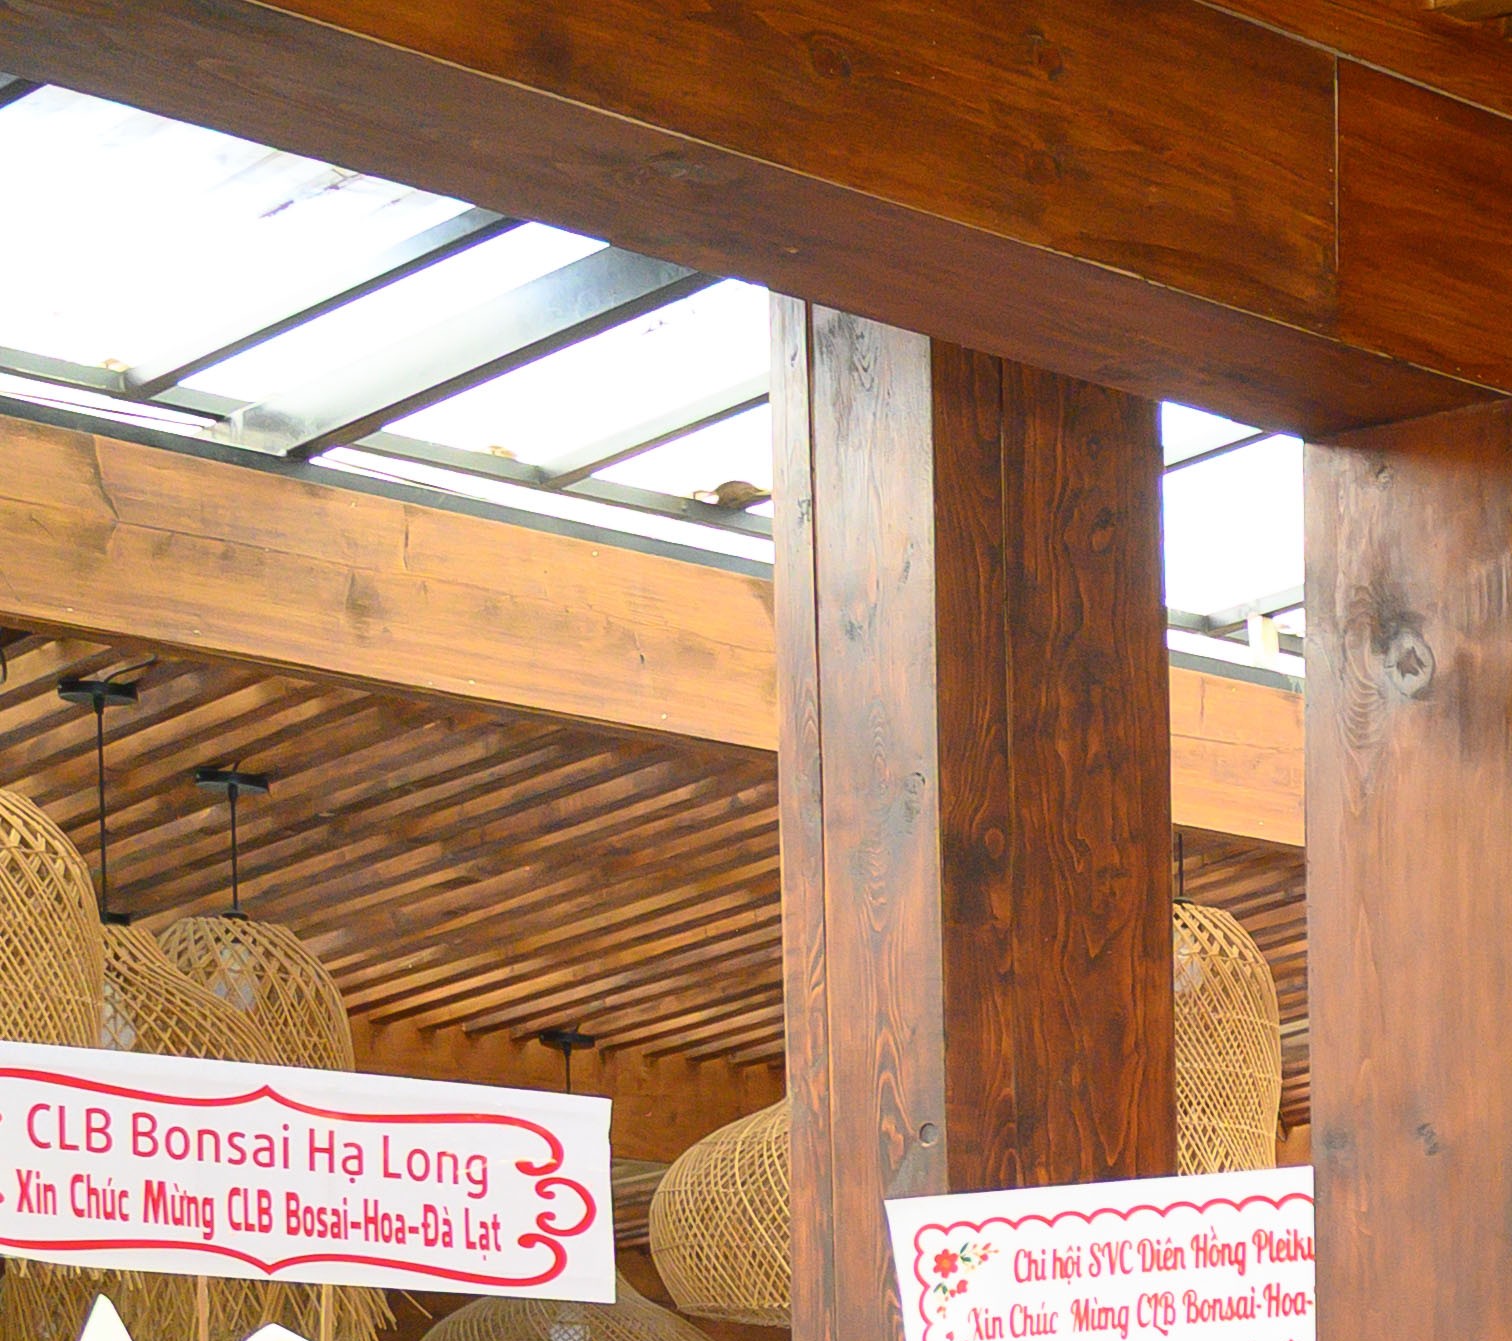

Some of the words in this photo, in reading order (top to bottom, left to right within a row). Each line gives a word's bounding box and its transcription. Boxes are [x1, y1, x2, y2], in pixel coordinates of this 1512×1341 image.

[27, 1103, 113, 1154] CLB
[132, 1111, 290, 1170] Bonsai
[308, 1128, 364, 1184] Hạ
[382, 1135, 489, 1200] Long
[15, 1168, 58, 1216] Xin
[70, 1172, 130, 1222] Chúc
[143, 1179, 215, 1241] Mừng
[227, 1186, 274, 1234] CLB
[464, 1206, 502, 1261] Lạt
[1013, 1246, 1047, 1283] Chi
[1051, 1242, 1082, 1286] hội
[1088, 1239, 1134, 1278] SVC
[1136, 1236, 1186, 1273] Diên
[1190, 1225, 1247, 1276] Hồng
[1252, 1228, 1316, 1264] Pleiku
[967, 1306, 1004, 1341] Xin
[1009, 1299, 1059, 1339] Chúc
[1136, 1290, 1177, 1336] CLB
